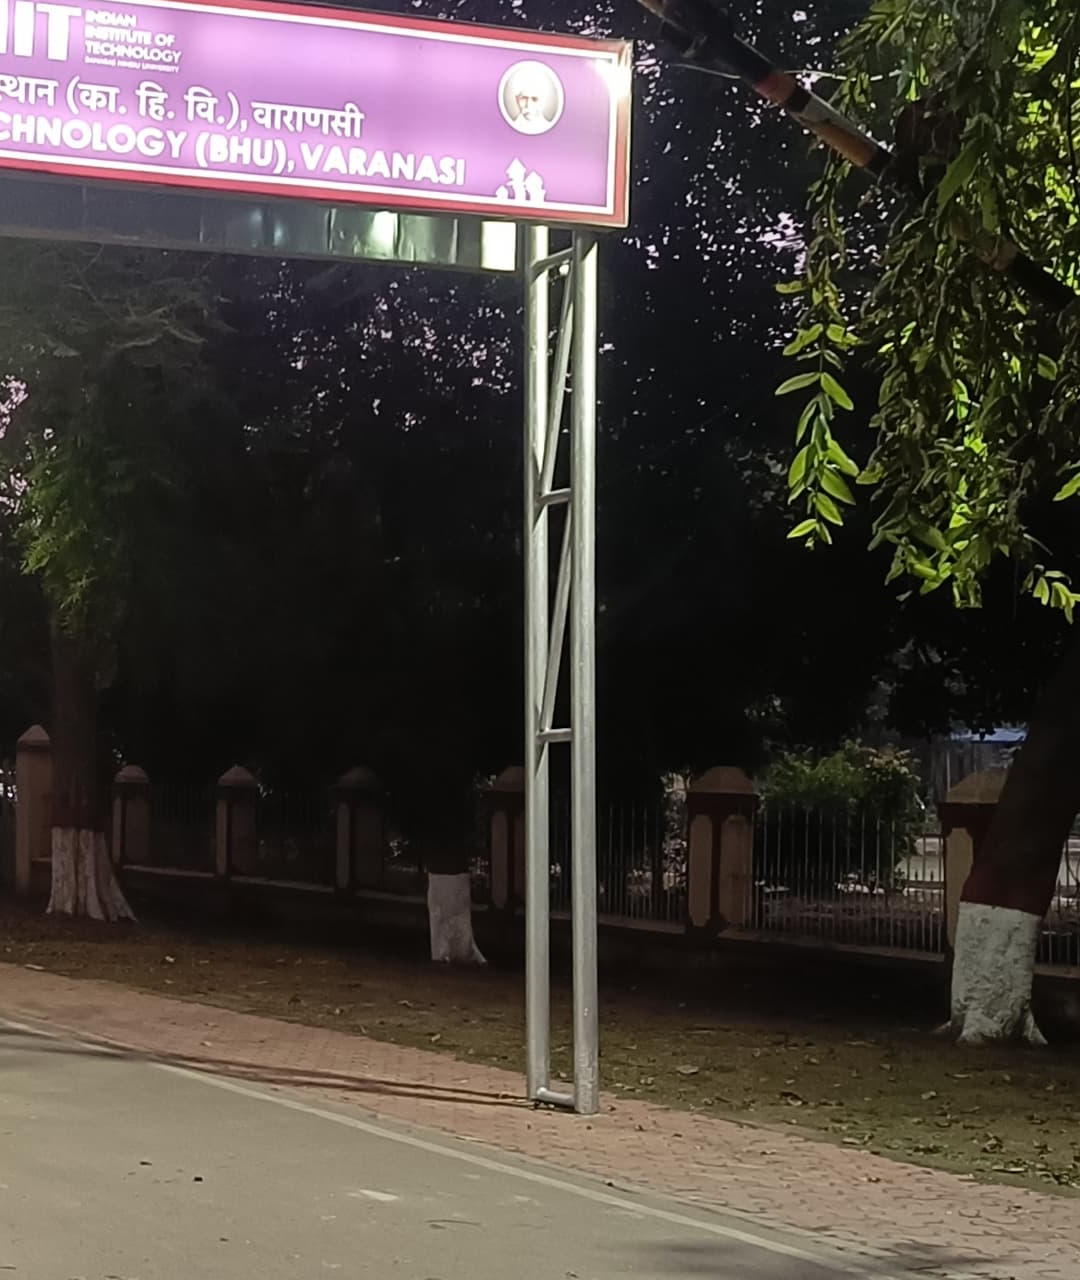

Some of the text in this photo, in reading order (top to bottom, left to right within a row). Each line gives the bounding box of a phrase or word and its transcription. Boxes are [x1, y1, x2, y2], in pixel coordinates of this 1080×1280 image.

[84, 8, 138, 28] INDIAN
[84, 24, 176, 47] INSTITUTE OF
[84, 39, 182, 63] TECHNOLOGY
[66, 75, 127, 116] (का.
[135, 81, 175, 121] हि.
[250, 102, 366, 139] वाराणसी
[195, 131, 295, 174] (BHU),
[299, 142, 466, 186] VARANASI
